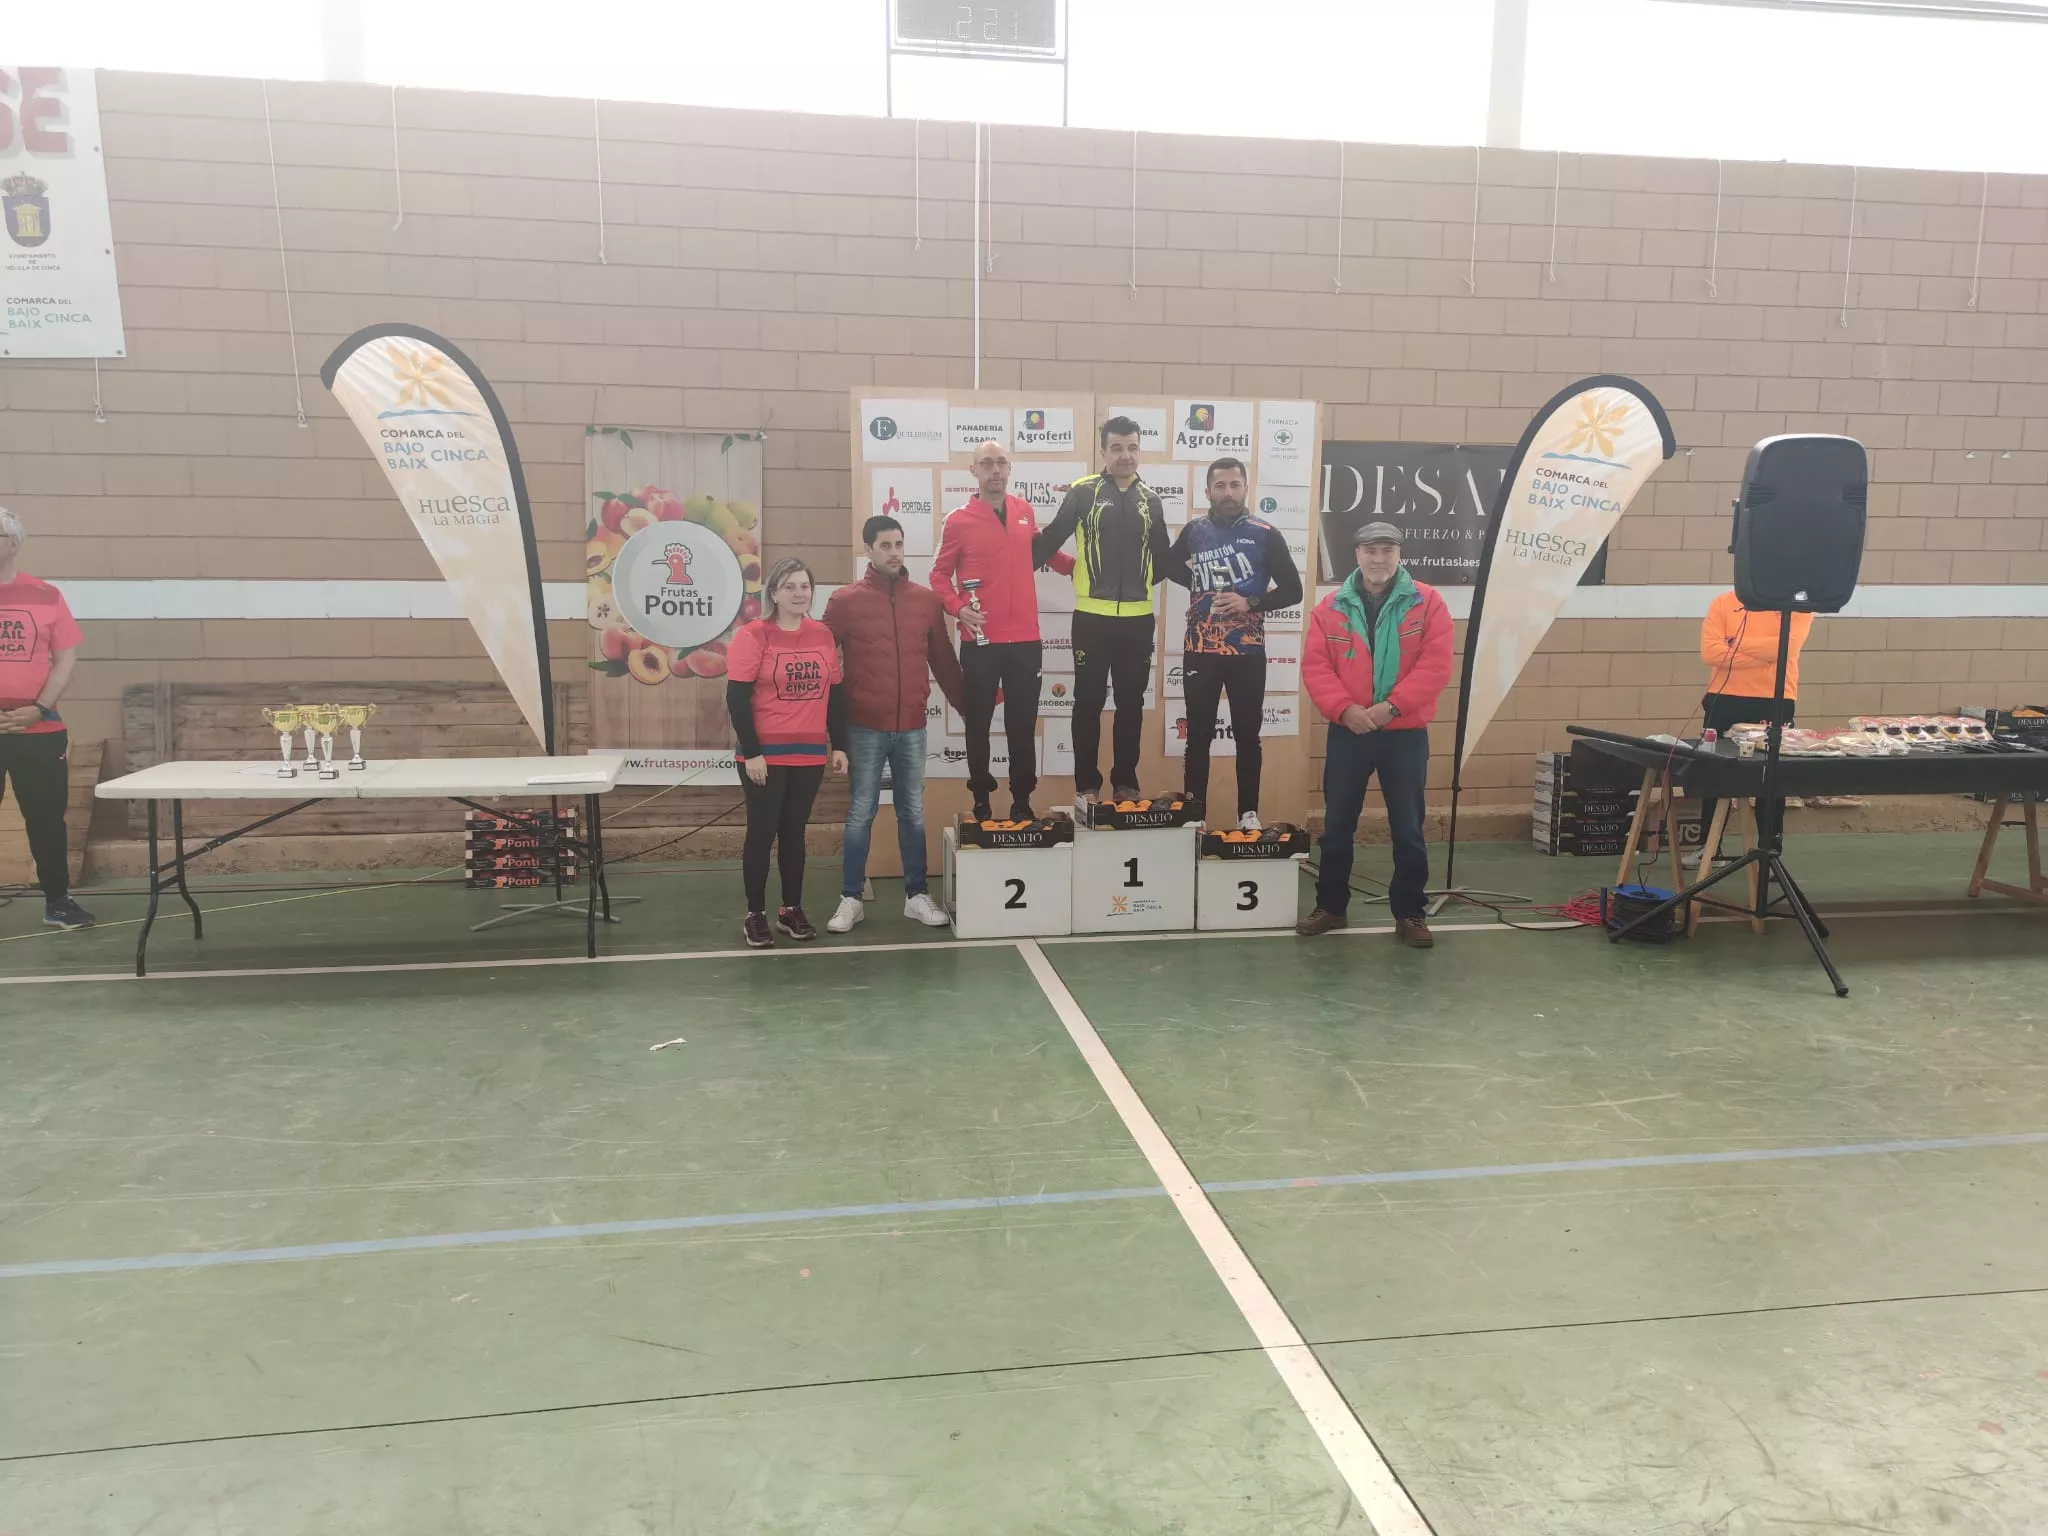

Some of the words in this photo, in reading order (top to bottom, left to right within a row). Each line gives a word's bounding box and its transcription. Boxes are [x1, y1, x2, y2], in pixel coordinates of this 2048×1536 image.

[6, 297, 56, 305] COMARCA
[8, 307, 41, 318] BAJO
[45, 312, 92, 323] CINCA
[9, 319, 42, 329] BAIX
[380, 428, 445, 439] COMARCA
[447, 430, 465, 439] DEL
[956, 424, 1004, 432] PANADERIA
[1017, 429, 1072, 443] Agroferti
[1176, 431, 1249, 449] Agroferti
[384, 441, 425, 456] BAJO
[431, 448, 489, 461] CINCA
[387, 457, 428, 470] BAIX
[1535, 467, 1590, 486] COMARCA
[1592, 480, 1609, 489] DEL
[1320, 464, 1506, 516] DESA
[1531, 477, 1569, 495] BAJO
[1527, 493, 1566, 510] BAIX
[1570, 494, 1621, 514] CINCA
[1403, 528, 1460, 540] FUERZO
[1464, 528, 1473, 540] &
[1478, 529, 1486, 540] P
[1198, 543, 1236, 563] MARATÓN
[1400, 556, 1480, 567] ww.frutaslaes
[660, 586, 699, 597] Frutas
[645, 595, 713, 616] Ponti
[1266, 609, 1301, 620] ORGES
[0, 630, 26, 639] AIL
[785, 661, 820, 672] COPA
[786, 671, 822, 681] TRAIL
[786, 683, 820, 692] CINCA
[507, 839, 539, 848] Ponti
[508, 858, 540, 867] Ponti
[1123, 857, 1144, 888] 1
[508, 877, 540, 886] Ponti
[1004, 878, 1027, 910] 2
[1236, 880, 1259, 911] 3
